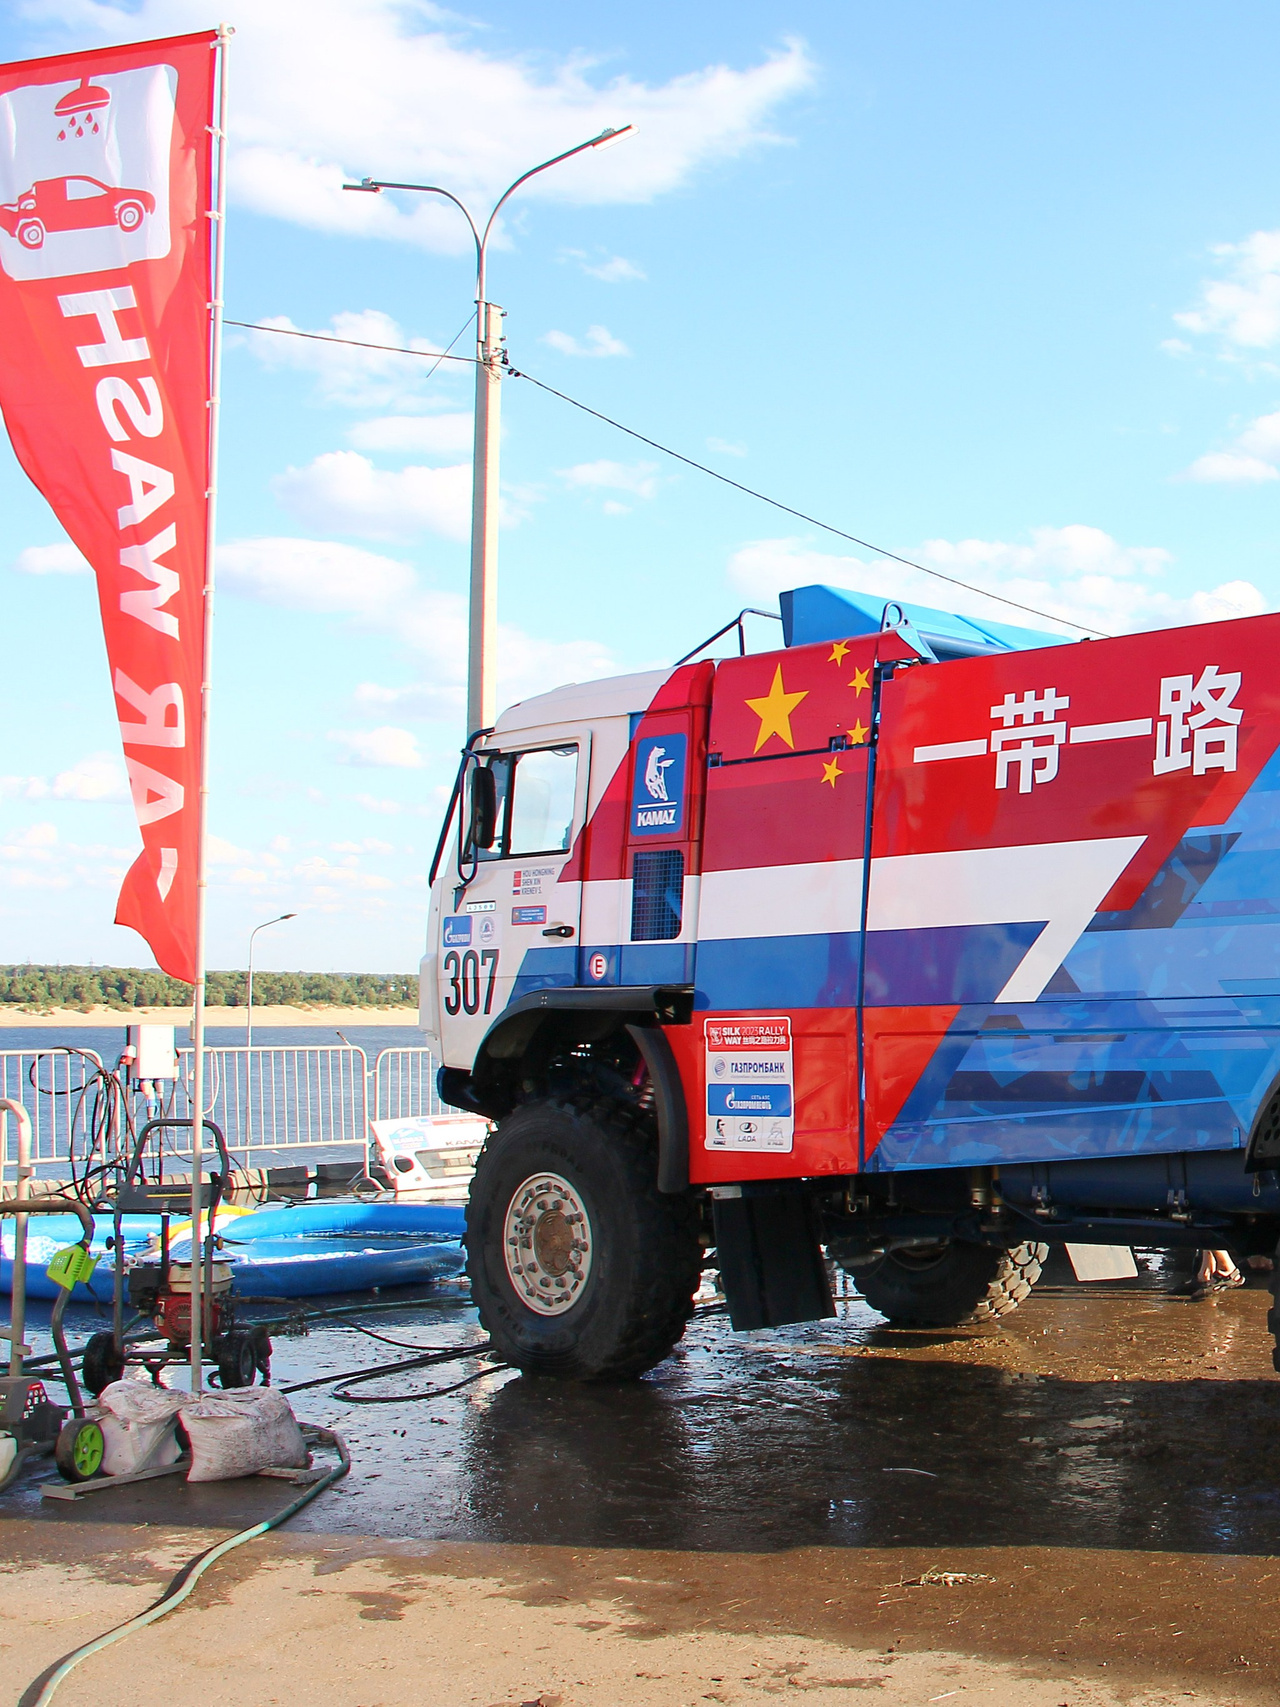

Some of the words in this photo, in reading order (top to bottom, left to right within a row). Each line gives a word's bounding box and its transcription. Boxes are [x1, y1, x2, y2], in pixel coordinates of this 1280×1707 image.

[913, 665, 1244, 794] 一带一路
[636, 809, 676, 827] KAMAZ
[521, 879, 532, 887] SHEN
[594, 959, 603, 974] E
[443, 949, 500, 1016] 307
[722, 1026, 741, 1036] SILK
[741, 1026, 759, 1036] 2023
[758, 1026, 785, 1035] RALLY
[724, 1036, 742, 1045] WAY
[730, 1062, 785, 1073] ГАЗПРОМБАНК
[445, 1138, 485, 1146] KAMA
